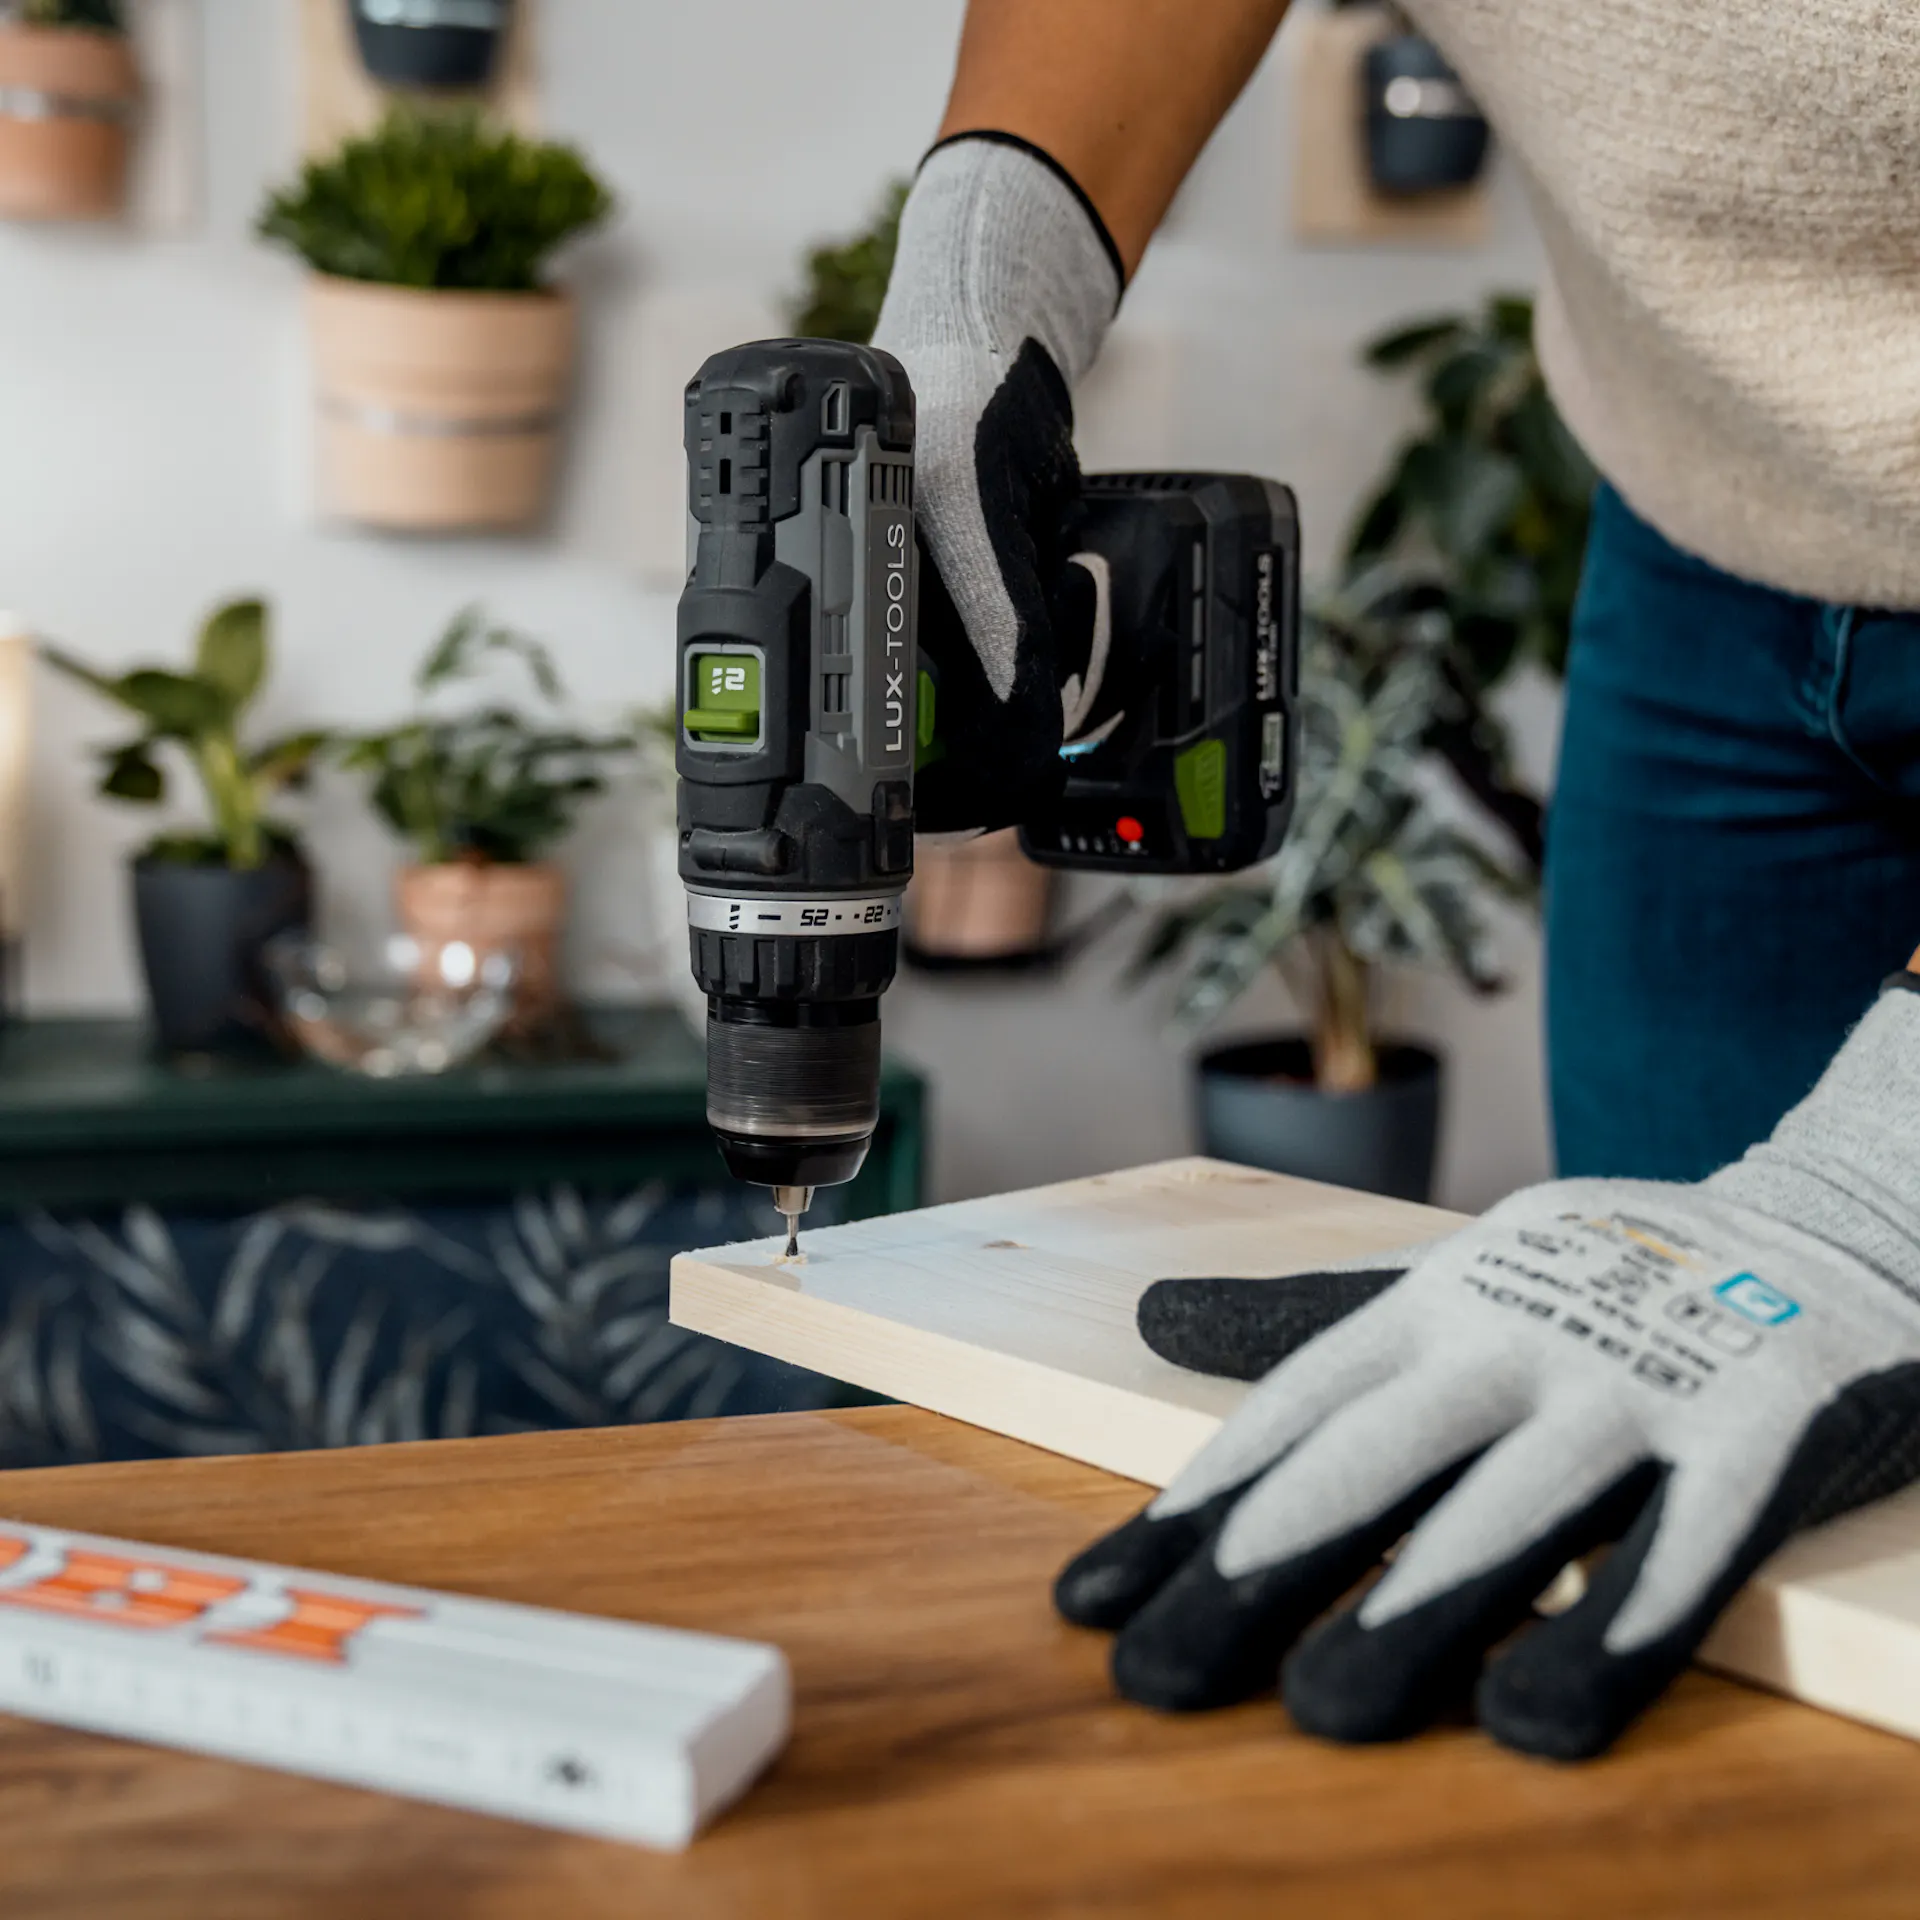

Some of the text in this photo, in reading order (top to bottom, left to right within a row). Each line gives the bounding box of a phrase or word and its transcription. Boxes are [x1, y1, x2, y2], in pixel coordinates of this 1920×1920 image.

[886, 523, 906, 752] LUX-TOOLS
[1256, 554, 1273, 702] LUX-TOOLS
[863, 905, 884, 925] 22
